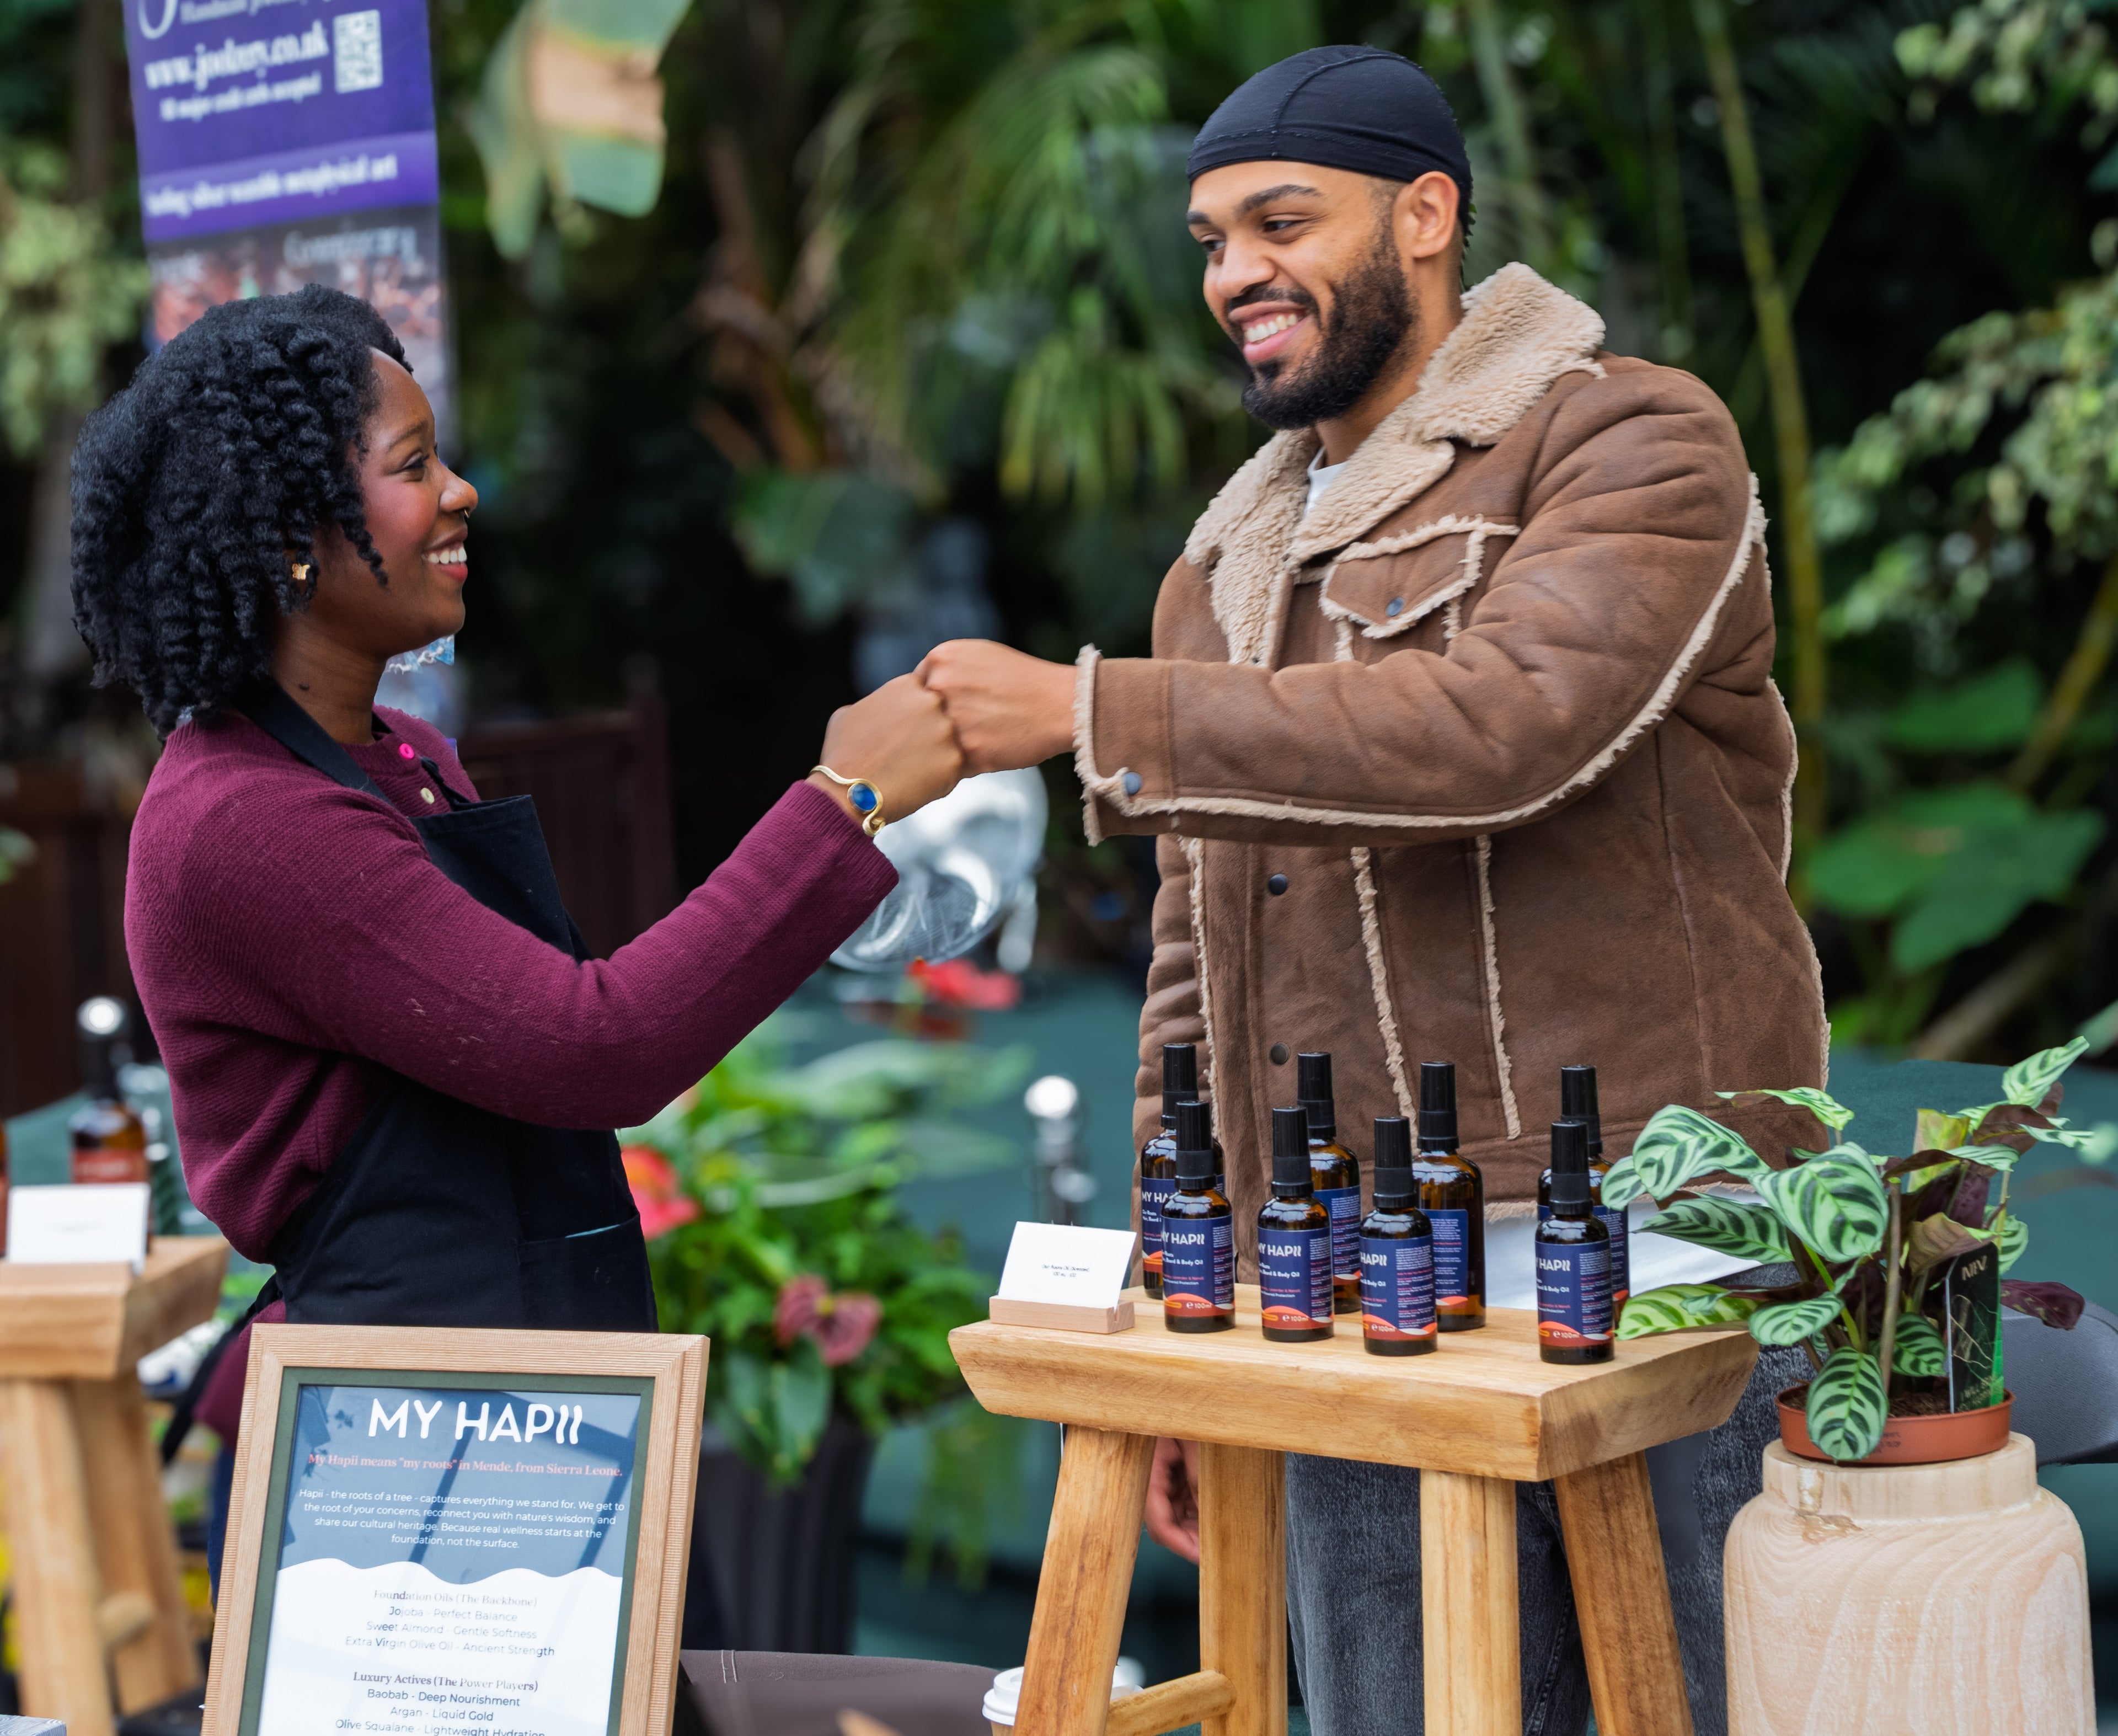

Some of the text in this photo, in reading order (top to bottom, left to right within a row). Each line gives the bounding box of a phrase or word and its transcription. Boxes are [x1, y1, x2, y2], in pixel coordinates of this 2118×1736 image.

[368, 1398, 442, 1439] MY
[309, 1454, 623, 1477] My Hapii means "my roots" in Mende, from Sierra Leone.
[299, 1489, 323, 1499] Hapii
[331, 1490, 347, 1499] the
[374, 1492, 384, 1500] of
[393, 1493, 412, 1502] tree
[420, 1493, 461, 1504] captures
[463, 1497, 514, 1509] everything
[532, 1499, 559, 1508] stand
[561, 1499, 575, 1509] for.
[579, 1501, 594, 1510] We
[596, 1504, 612, 1512] get
[615, 1503, 625, 1511] to
[304, 1502, 320, 1511] the
[343, 1504, 354, 1513] of
[353, 1507, 375, 1516] your
[377, 1507, 421, 1517] concerns,
[423, 1509, 470, 1519] reconnect
[472, 1512, 490, 1521] you
[492, 1510, 514, 1520] with
[516, 1513, 554, 1523] nature's
[555, 1514, 595, 1525] wisdom,
[597, 1516, 616, 1525] and
[314, 1517, 340, 1526] share
[360, 1519, 395, 1529] cultural
[398, 1520, 439, 1532] heritage.
[441, 1523, 481, 1532] Because
[483, 1525, 500, 1534] real
[503, 1526, 543, 1536] wellness
[545, 1528, 572, 1537] starts
[574, 1529, 584, 1538] at
[586, 1529, 602, 1539] the
[392, 1534, 445, 1545] foundation,
[466, 1537, 481, 1546] the
[483, 1539, 519, 1548] surface.
[374, 1590, 537, 1607] Foundation Oils (The Backbone)
[389, 1606, 423, 1617] Jojoba
[434, 1608, 470, 1619] Perfect
[475, 1611, 517, 1621] Balance
[367, 1621, 397, 1631] Sweet
[402, 1623, 443, 1633] Almond
[454, 1626, 489, 1636] Gentle
[493, 1628, 537, 1639] Softness
[346, 1636, 371, 1646] Extra
[376, 1637, 405, 1650] Virgin
[410, 1639, 435, 1649] Olive
[439, 1641, 453, 1650] Oil
[463, 1642, 505, 1653] Ancient
[509, 1645, 555, 1658] Strength
[354, 1671, 538, 1692] Luxury Actives (The Power Players)
[368, 1689, 408, 1700] Baobab
[419, 1691, 447, 1703] Deep
[450, 1694, 520, 1707] Nourishment
[391, 1706, 422, 1718] Argan
[433, 1708, 466, 1720] Liquid
[469, 1711, 493, 1721] Gold
[336, 1719, 361, 1729] Olive
[366, 1721, 414, 1733] Squalane
[425, 1725, 489, 1736] Lightweight
